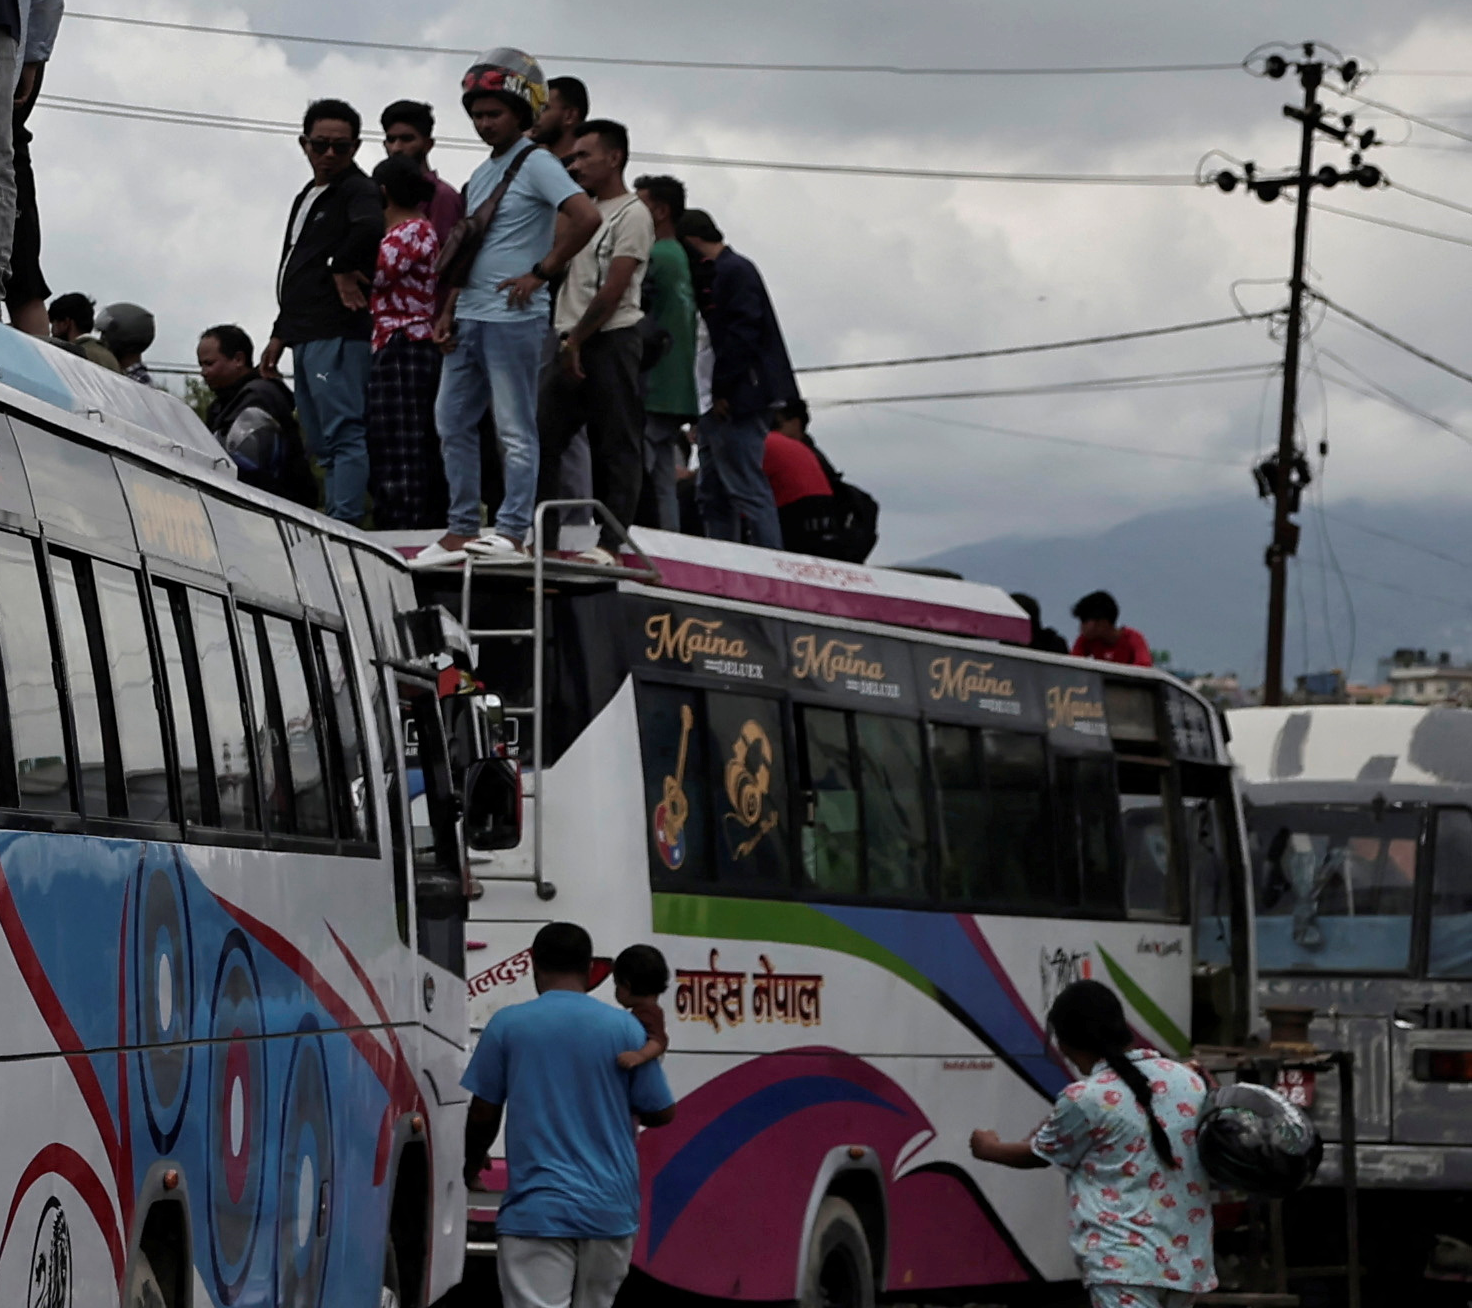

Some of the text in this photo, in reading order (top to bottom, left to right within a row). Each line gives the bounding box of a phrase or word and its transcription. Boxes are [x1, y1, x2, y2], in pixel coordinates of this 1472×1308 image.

[645, 612, 748, 664] Maina
[792, 634, 886, 683] Maina
[929, 657, 1014, 702] Maina
[753, 954, 823, 1026] नेपाल
